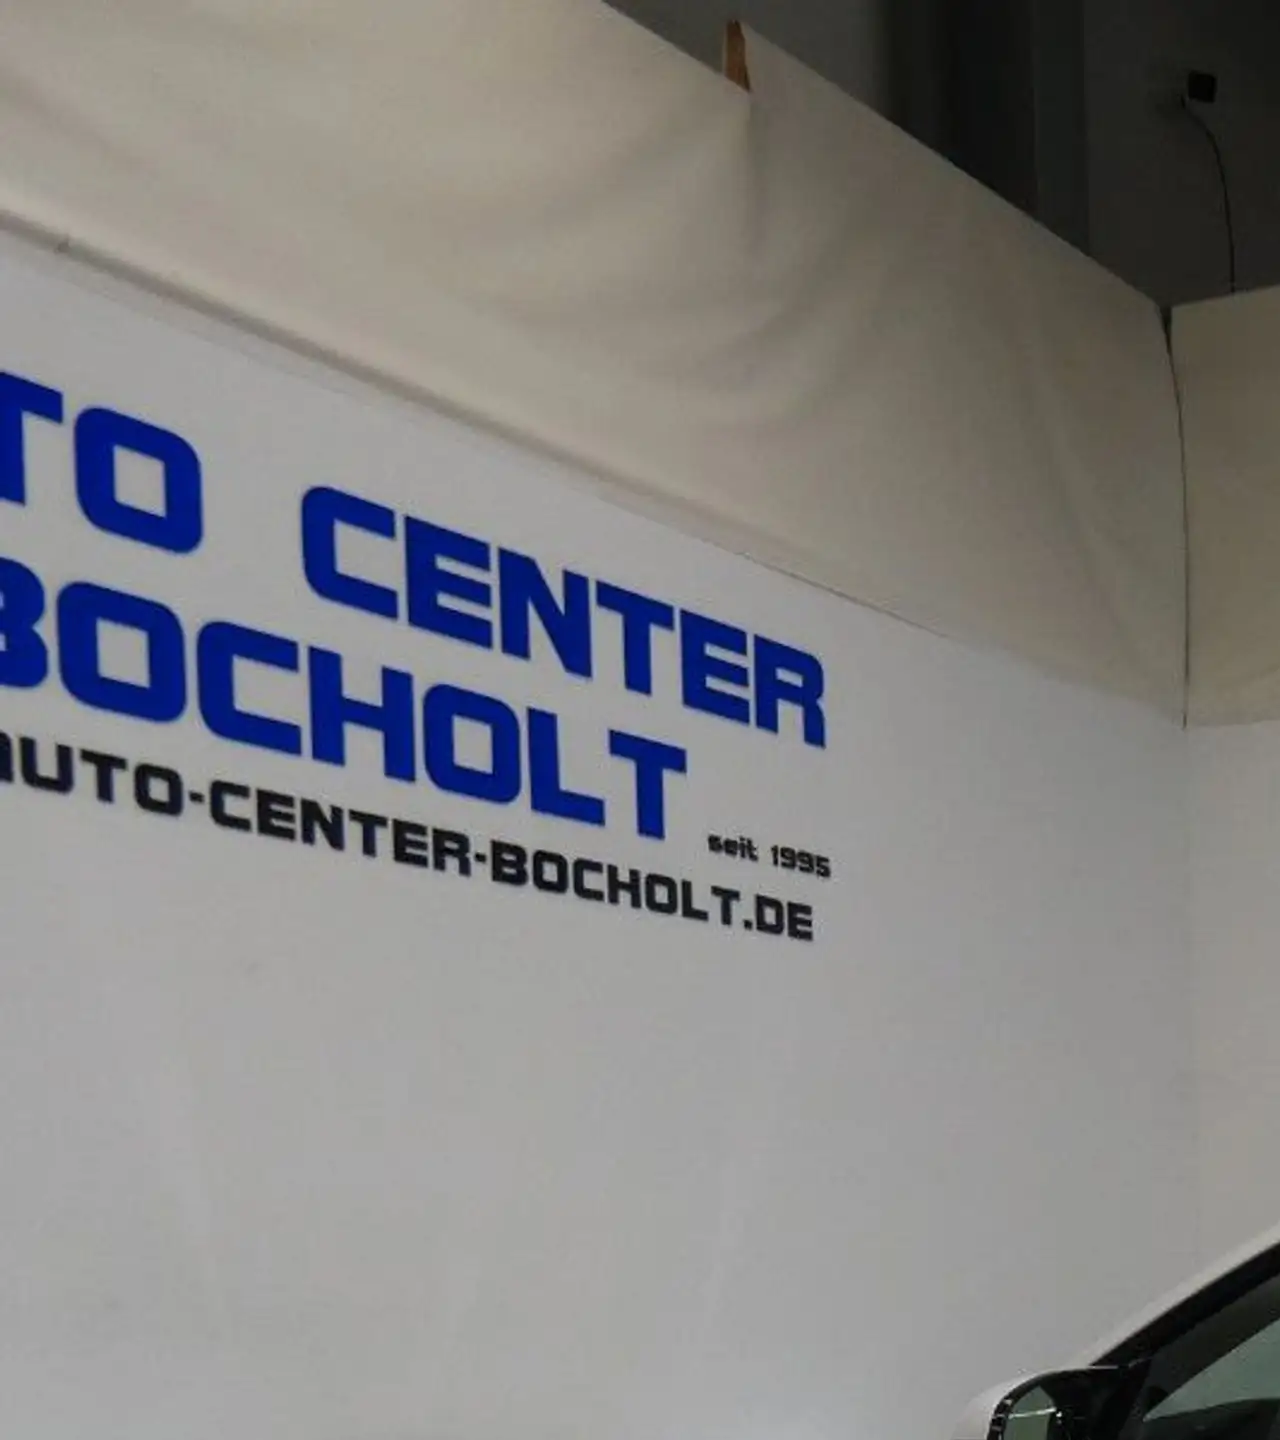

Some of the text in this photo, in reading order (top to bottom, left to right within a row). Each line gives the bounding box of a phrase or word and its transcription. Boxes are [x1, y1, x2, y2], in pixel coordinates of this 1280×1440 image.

[301, 487, 827, 746] CENTER
[0, 731, 814, 942] UTO-CENTER-BOCHOLT.DE
[707, 834, 758, 862] seit
[770, 844, 831, 879] 1995
